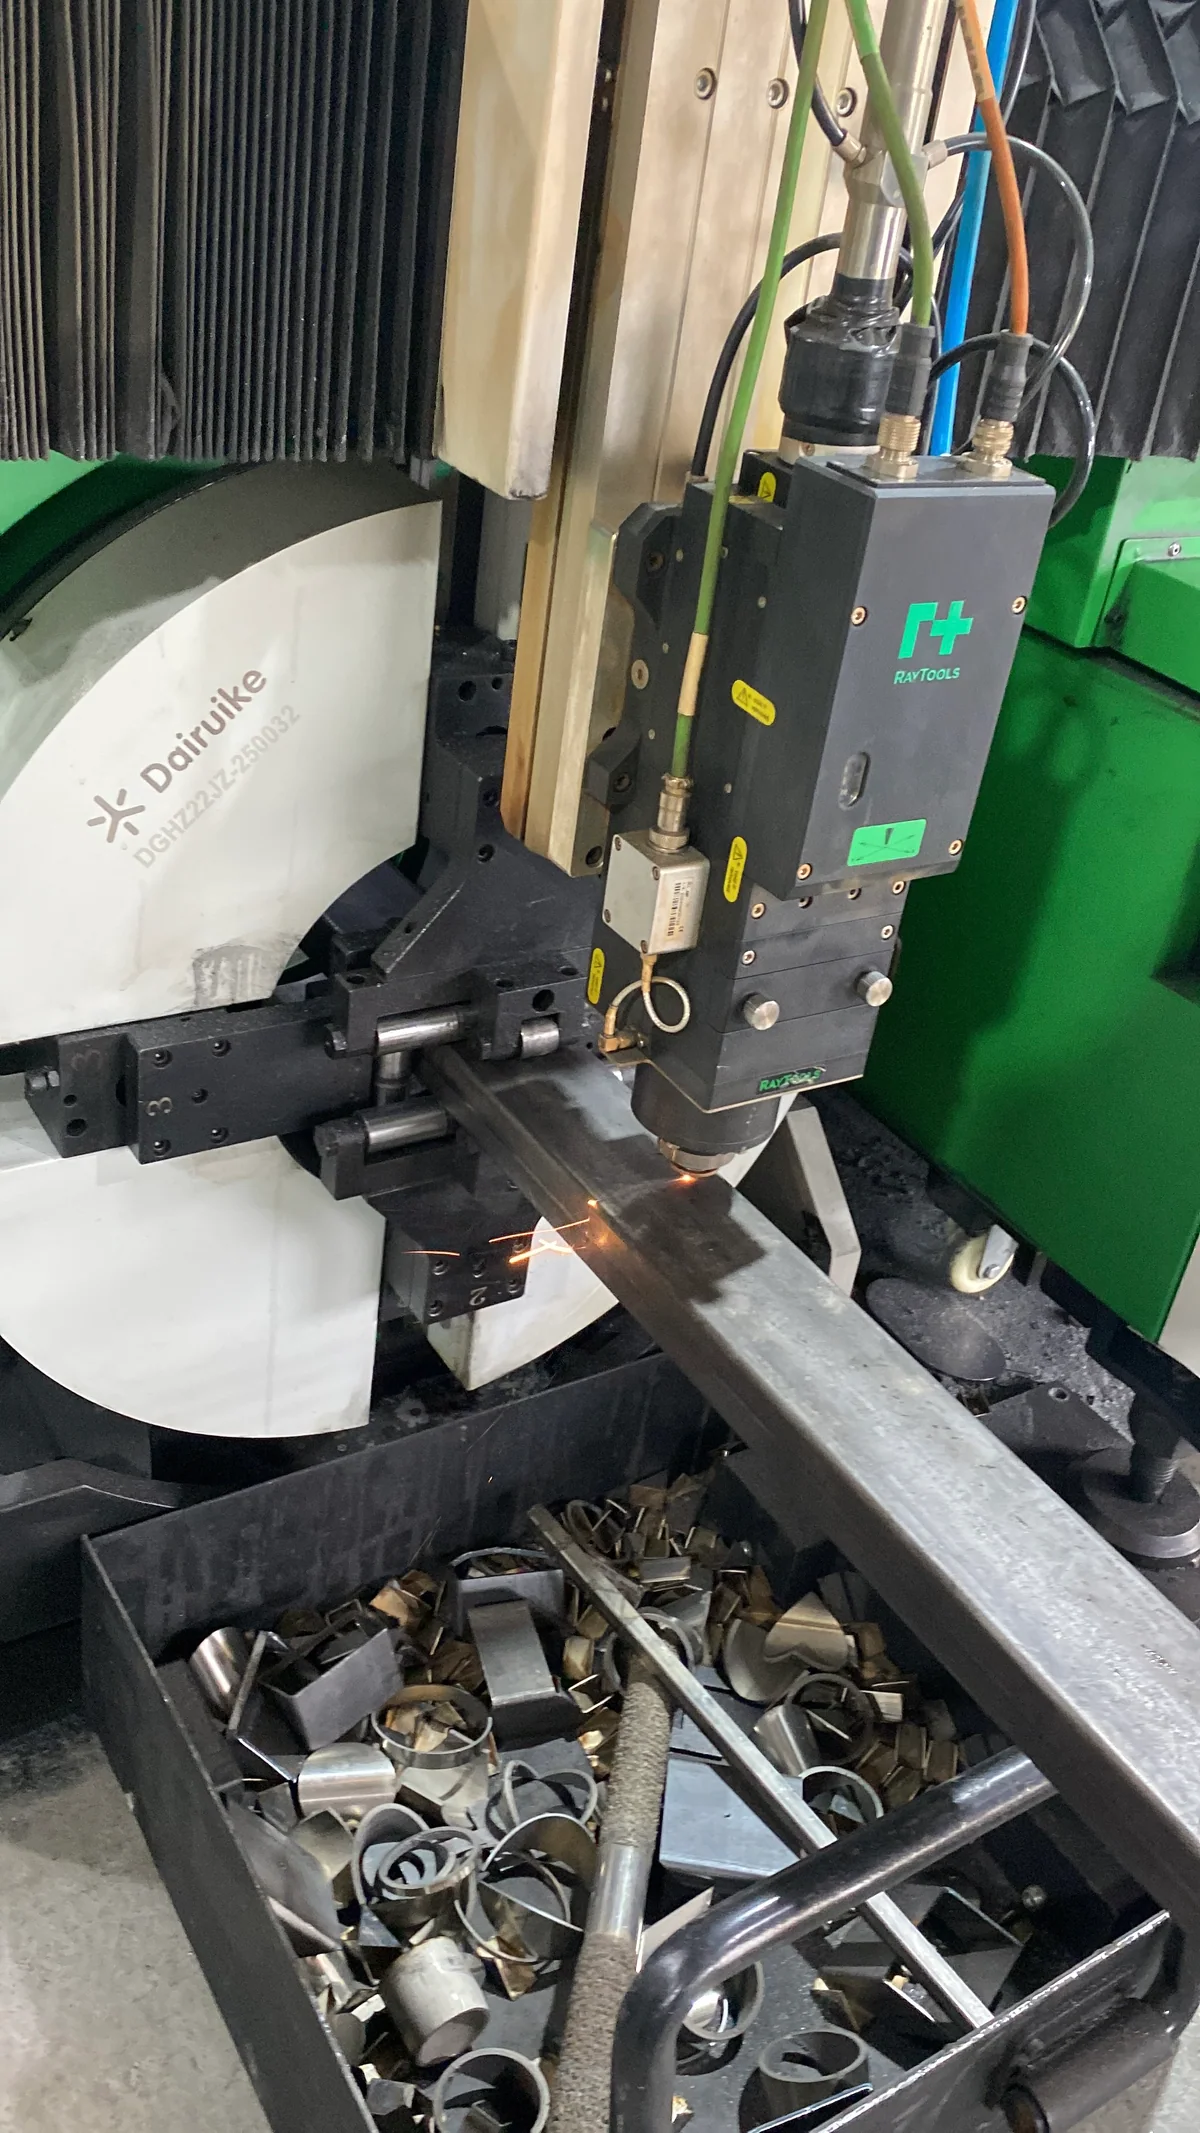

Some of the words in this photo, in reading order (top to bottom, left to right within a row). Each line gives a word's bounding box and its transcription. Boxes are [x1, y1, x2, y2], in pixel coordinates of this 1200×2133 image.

[140, 670, 267, 793] Dairuike
[132, 704, 299, 868] DGHZ22JZ-250032
[147, 1096, 173, 1117] 3
[469, 1286, 488, 1306] 2
